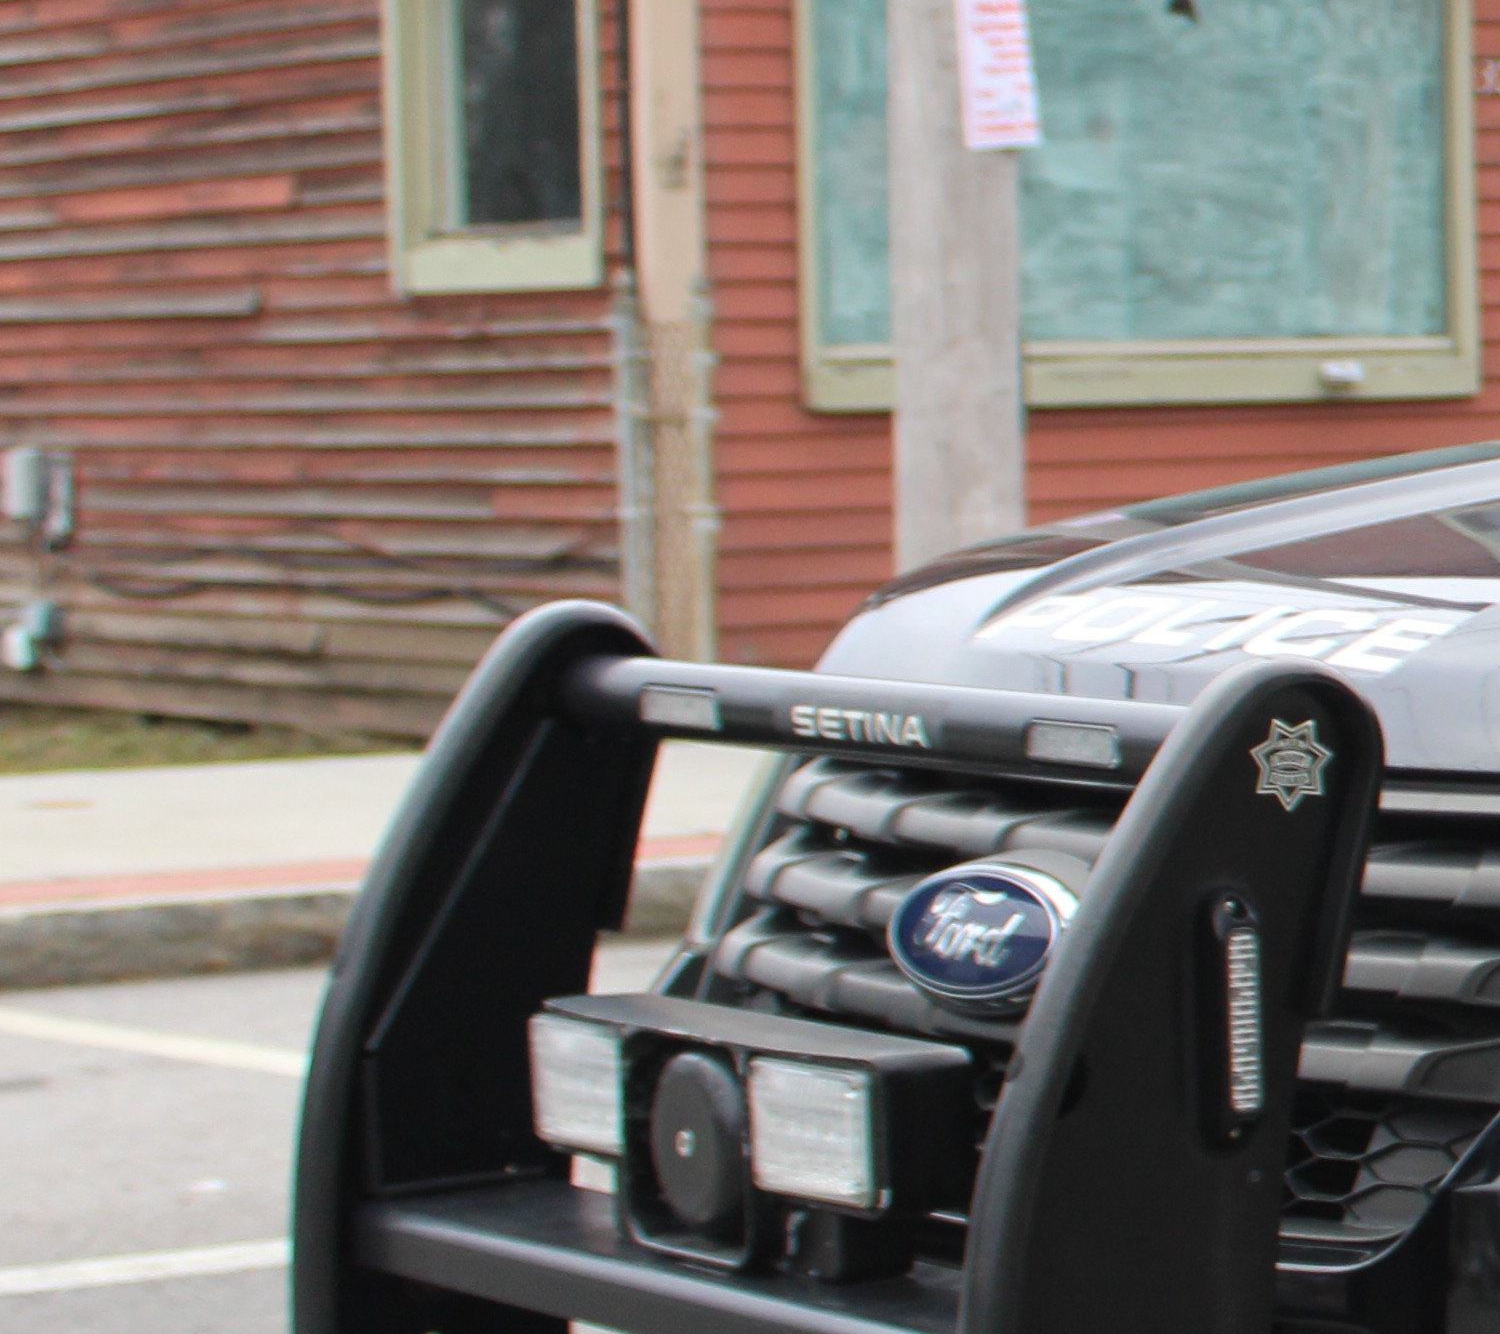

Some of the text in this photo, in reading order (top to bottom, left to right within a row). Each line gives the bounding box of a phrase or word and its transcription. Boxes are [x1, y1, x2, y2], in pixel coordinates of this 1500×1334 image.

[973, 594, 1458, 674] POLICE
[790, 705, 931, 749] SETINA
[913, 882, 1026, 967] Ford
